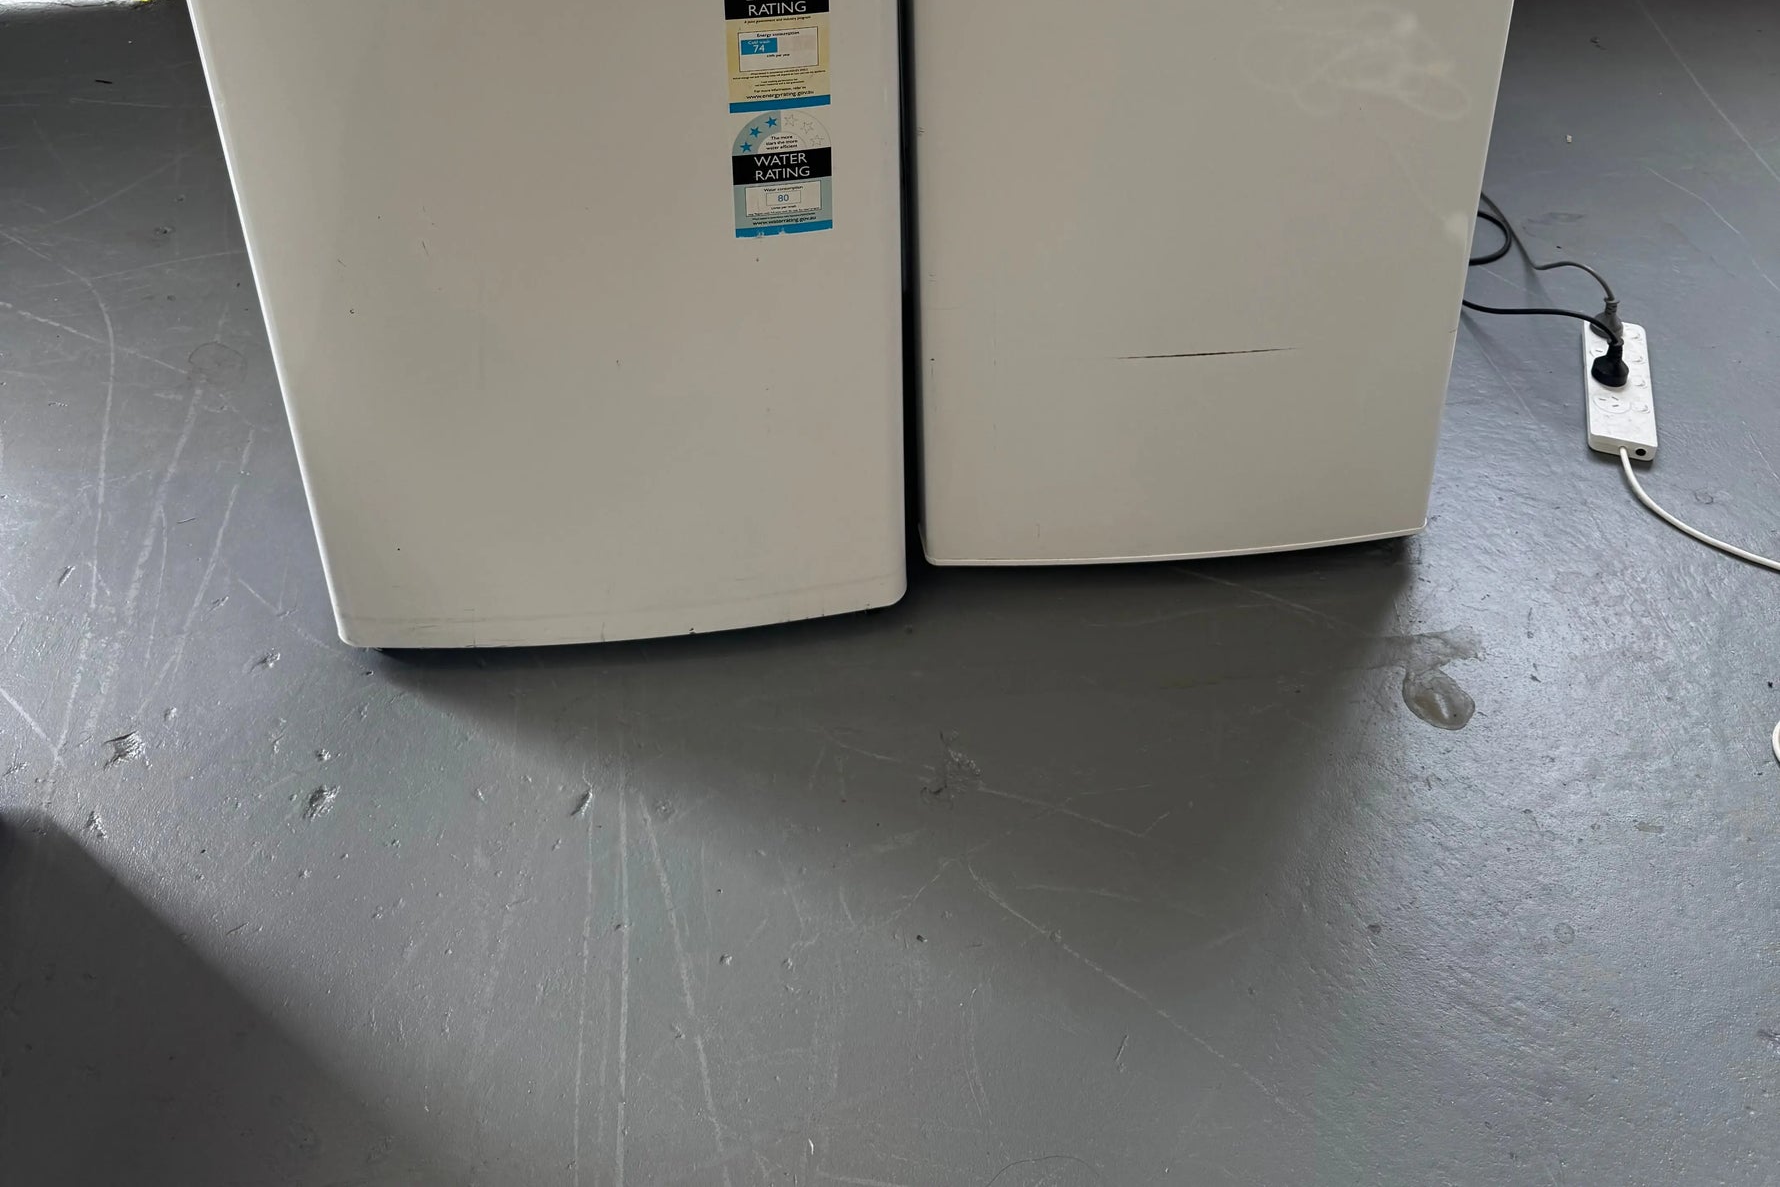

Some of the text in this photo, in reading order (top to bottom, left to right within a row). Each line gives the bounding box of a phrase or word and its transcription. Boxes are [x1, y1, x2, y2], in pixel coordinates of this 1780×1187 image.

[748, 1, 807, 16] RATING
[753, 44, 765, 53] 74
[745, 90, 814, 99] www.energyrating.gov.au
[754, 152, 808, 167] WATER
[755, 166, 810, 181] RATING
[777, 194, 790, 202] 80
[752, 216, 817, 225] www.waterrating.gov.au
